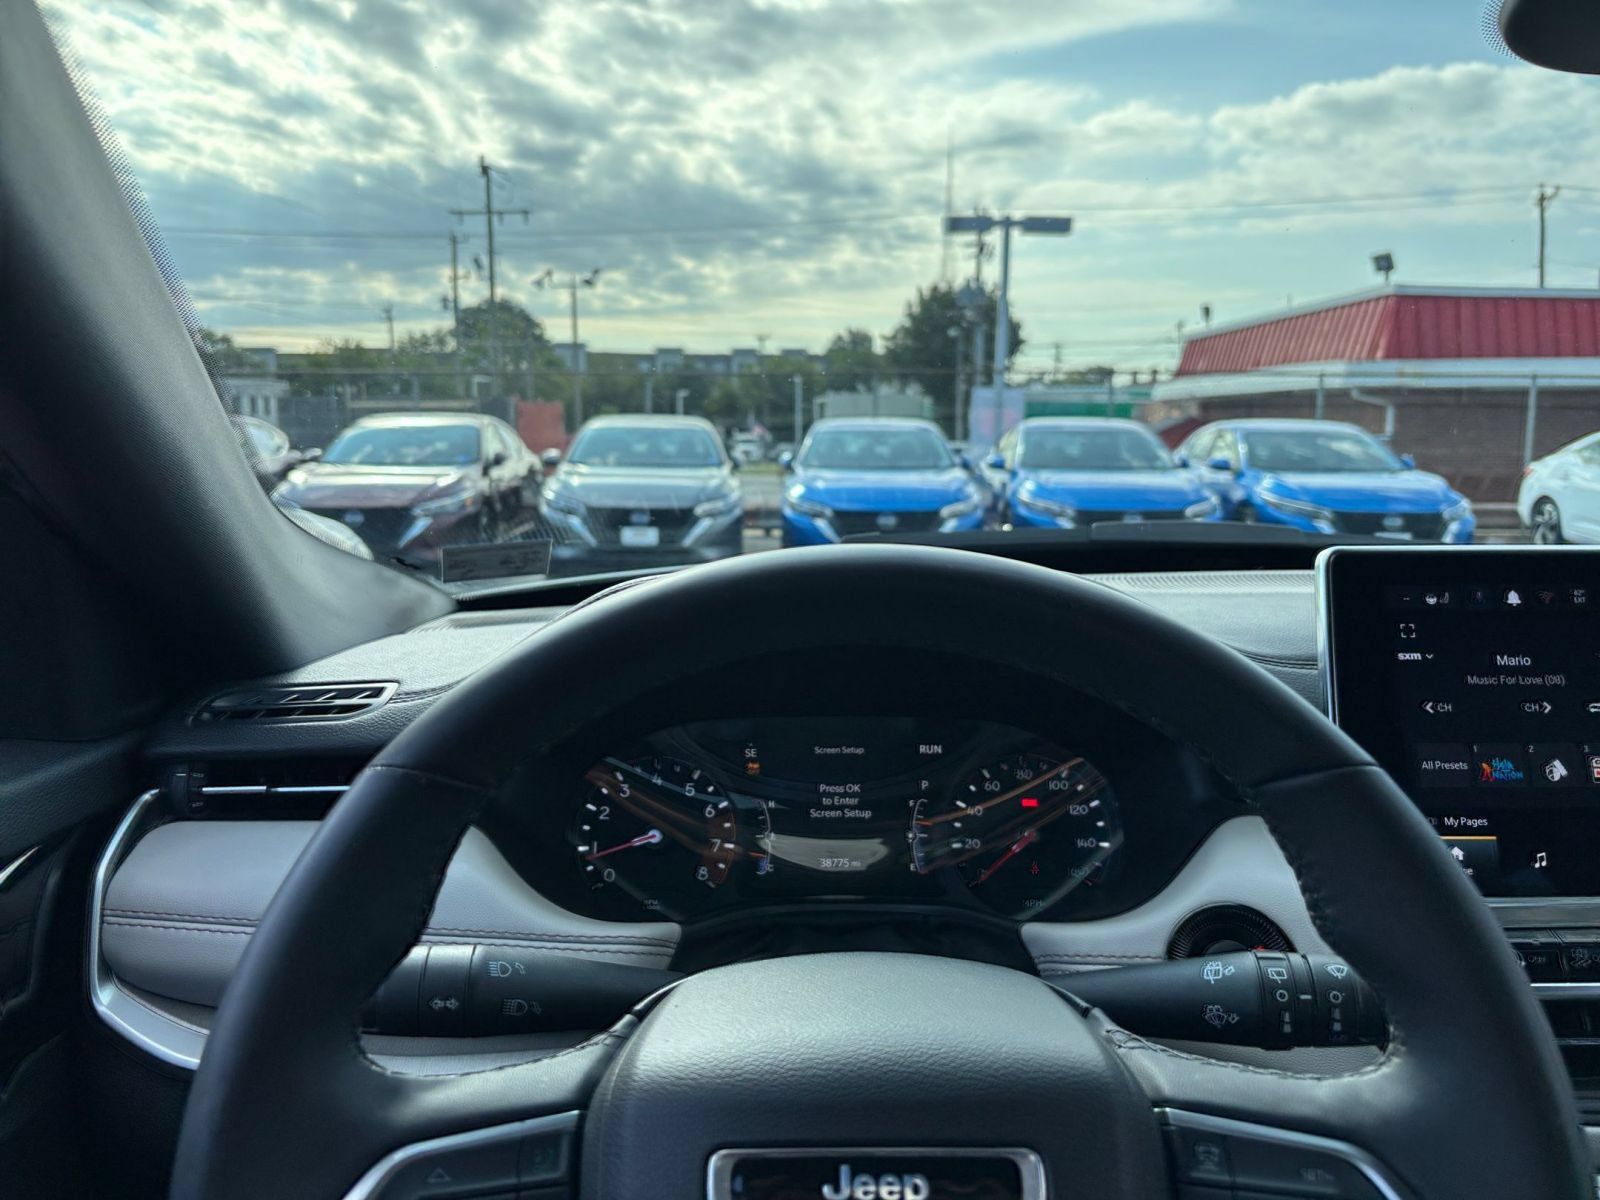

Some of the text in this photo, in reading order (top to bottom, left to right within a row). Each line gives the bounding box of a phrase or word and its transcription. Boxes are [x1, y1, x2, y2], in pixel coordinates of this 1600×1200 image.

[1397, 652, 1422, 660] sxm
[1496, 655, 1531, 666] Mario
[1467, 675, 1498, 685] Music
[1499, 675, 1516, 685] For
[1518, 675, 1543, 685] Love
[744, 747, 757, 758] SE
[814, 746, 865, 755] Screen Setup
[919, 744, 942, 754] RUN
[1528, 745, 1535, 753] 2
[1421, 760, 1469, 770] All Presets
[684, 784, 696, 797] 5
[819, 783, 861, 793] Press OK
[921, 780, 929, 790] P
[984, 781, 1000, 792] 60
[1048, 780, 1069, 790] 100
[619, 785, 630, 798] 3
[822, 796, 859, 805] to Enter
[599, 808, 611, 819] 2
[705, 805, 715, 818] 6
[809, 808, 872, 819] Screen Setup
[1069, 805, 1088, 815] 120
[1444, 816, 1488, 828] My Pages
[709, 838, 721, 852] 7
[965, 838, 981, 849] 20
[1077, 838, 1096, 848] 140
[820, 858, 850, 867] 38775
[603, 869, 615, 882] 0
[697, 866, 708, 881] 8
[821, 1163, 930, 1200] Jeep
